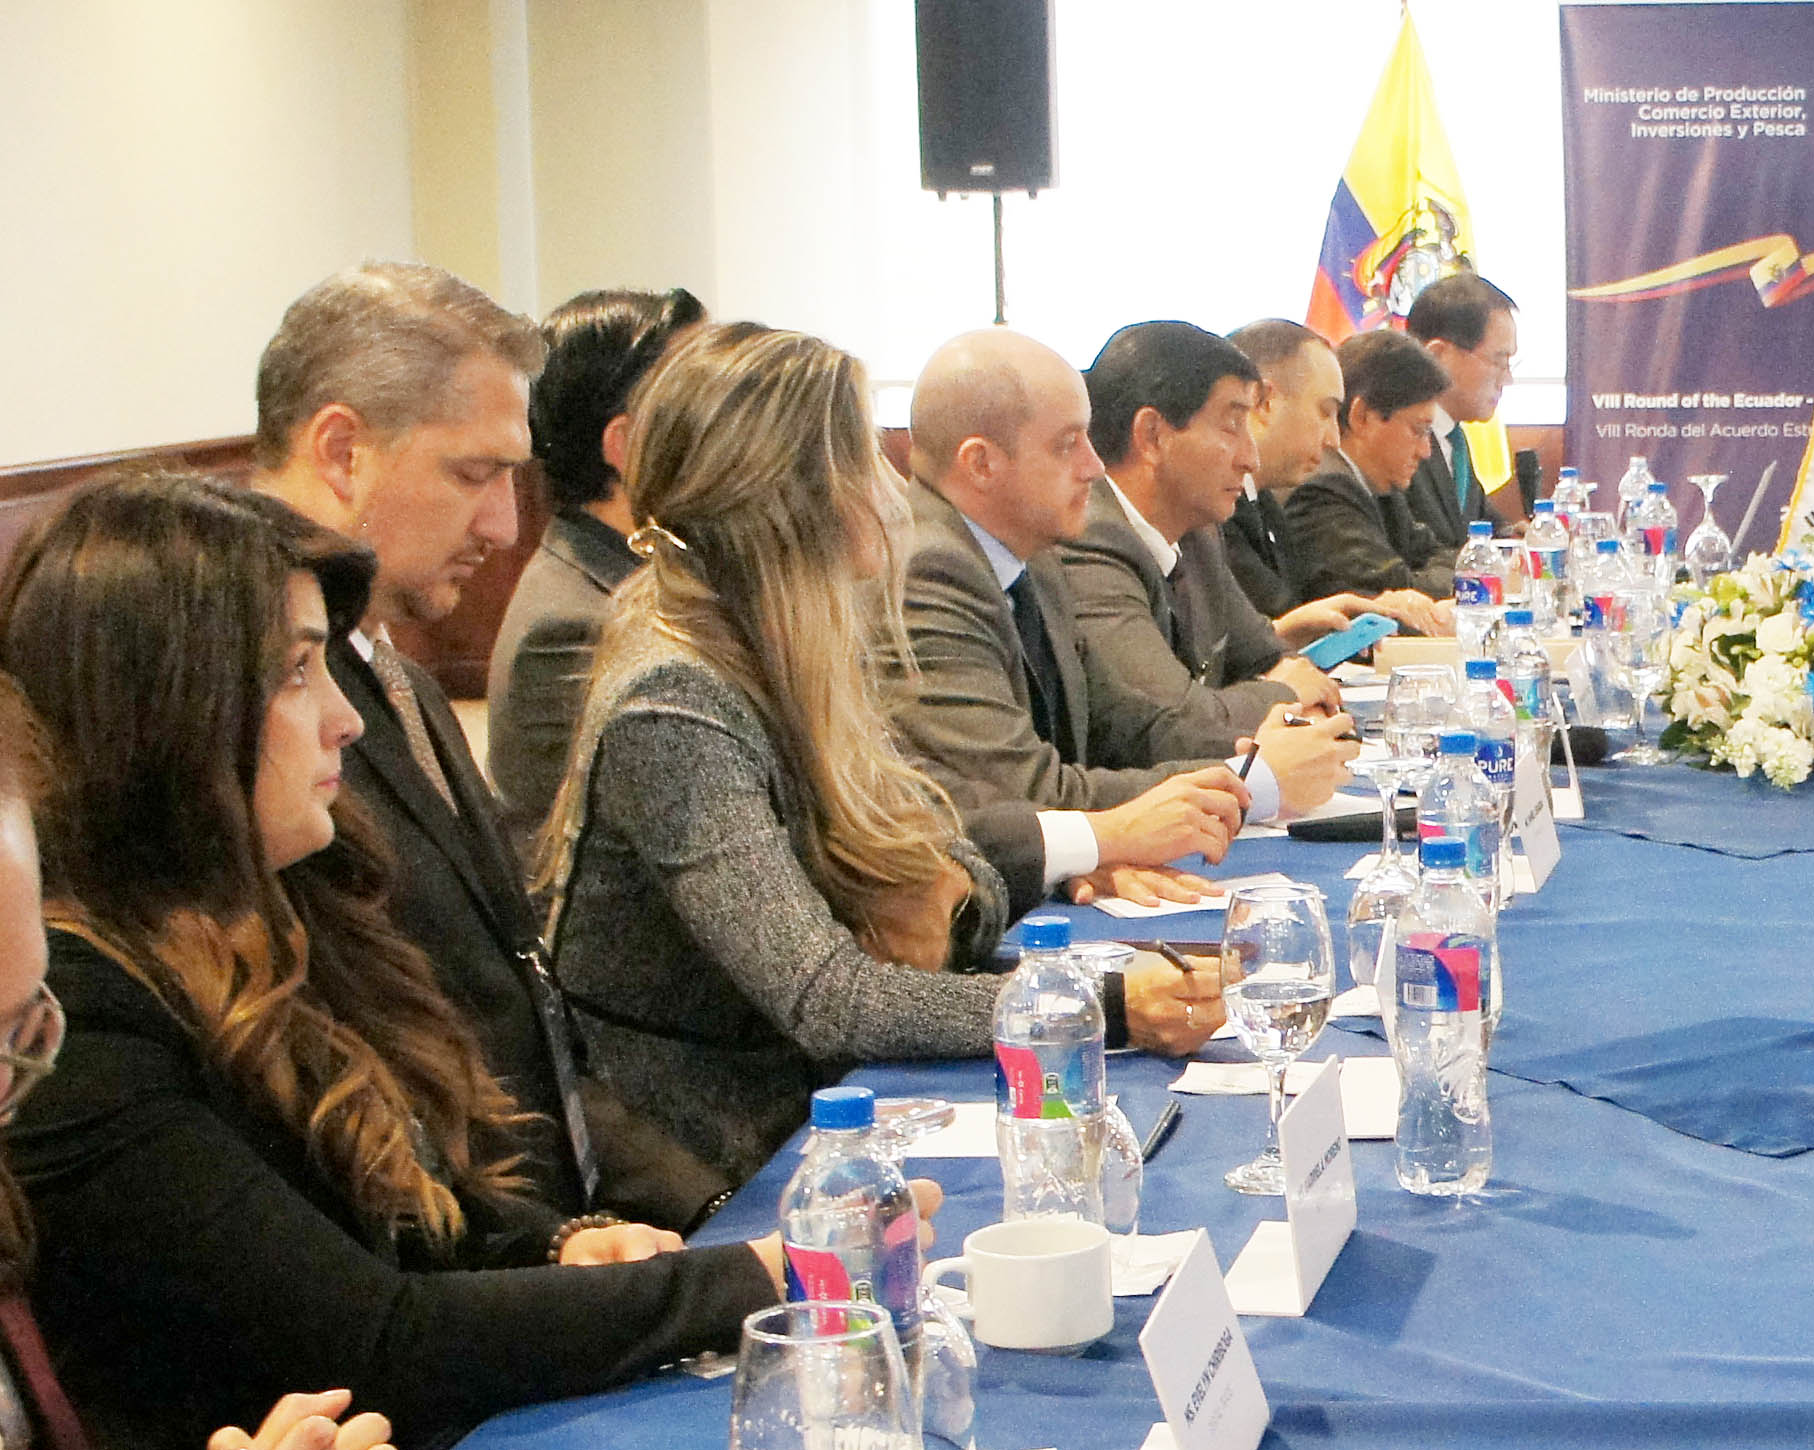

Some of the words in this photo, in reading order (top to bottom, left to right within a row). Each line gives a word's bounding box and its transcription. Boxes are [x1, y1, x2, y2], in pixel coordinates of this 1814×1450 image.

[1584, 87, 1671, 103] Ministerio
[1675, 86, 1699, 102] de
[1703, 86, 1806, 102] Producción
[1638, 104, 1725, 120] Comercio
[1730, 104, 1807, 121] Exterior,
[1631, 121, 1733, 138] Inversiones
[1736, 123, 1748, 139] y
[1753, 120, 1806, 137] Pesca
[1592, 393, 1620, 409] VIII
[1624, 393, 1678, 409] Round
[1681, 392, 1700, 409] of
[1702, 392, 1730, 409] the
[1733, 392, 1804, 409] Ecuador
[1596, 424, 1620, 438] VIII
[1625, 424, 1677, 438] Ronda
[1680, 423, 1705, 438] del
[1710, 423, 1778, 438] Acuerdo
[1478, 757, 1514, 774] PURE
